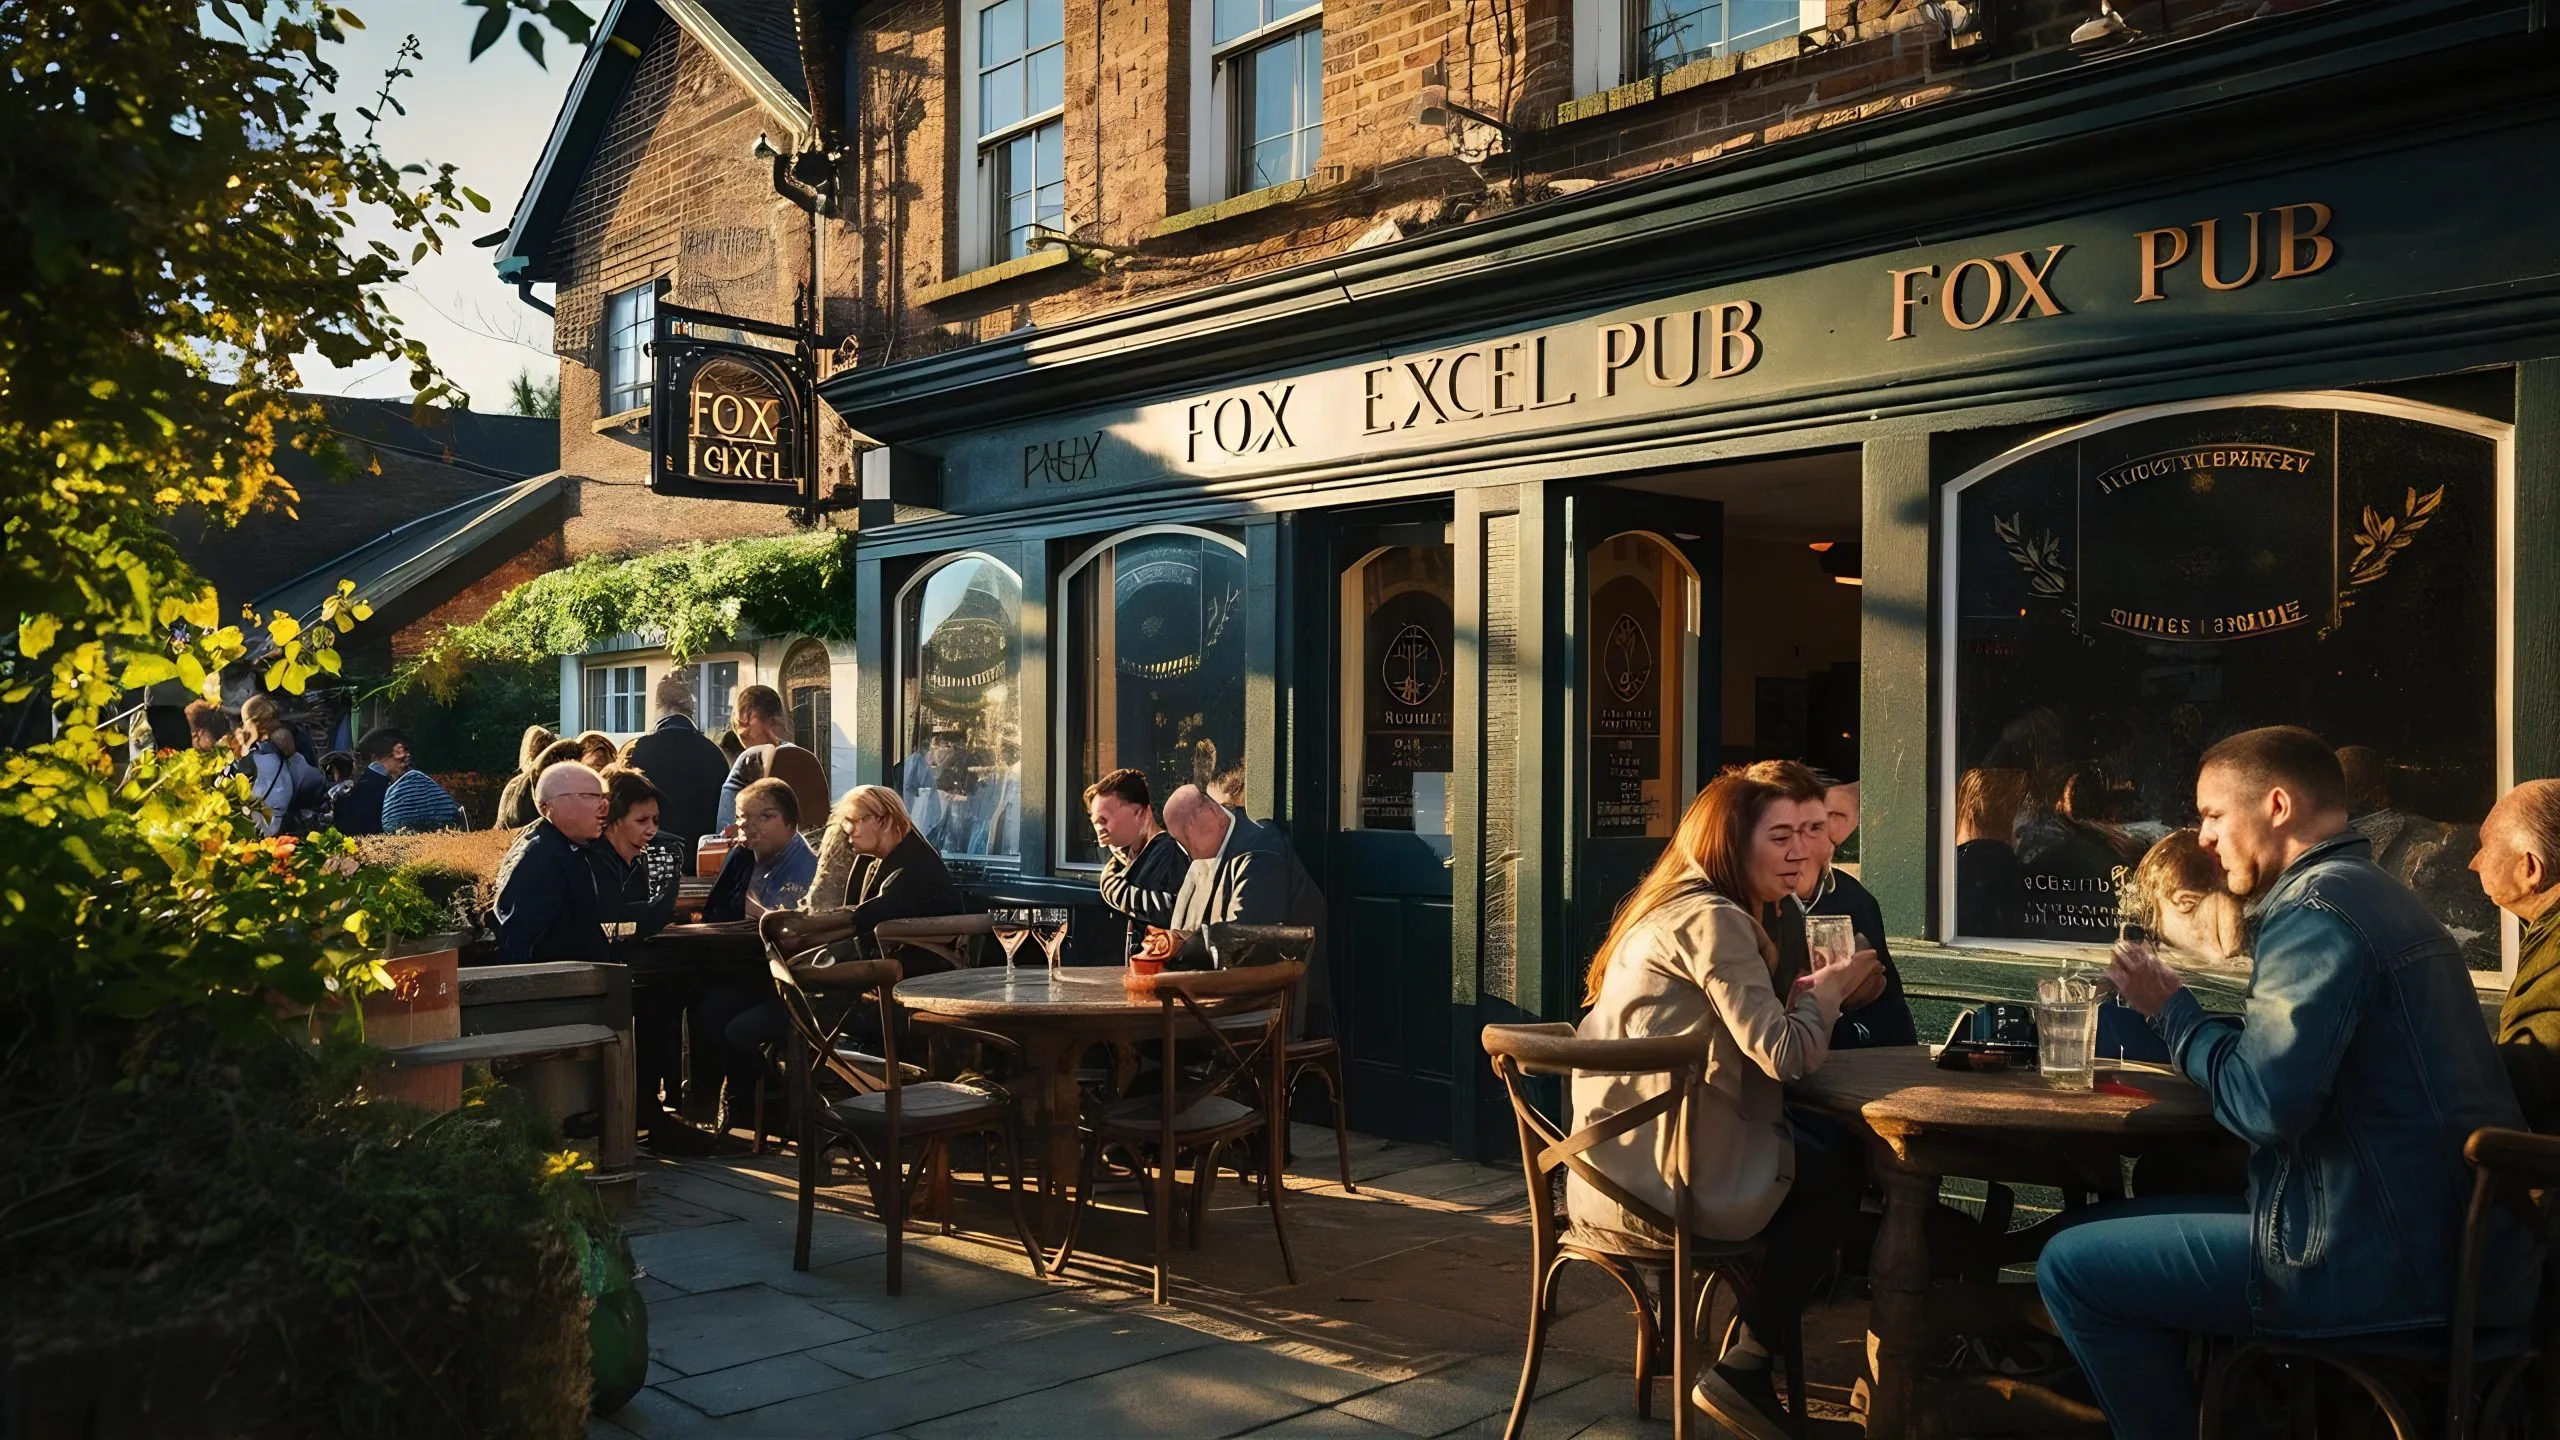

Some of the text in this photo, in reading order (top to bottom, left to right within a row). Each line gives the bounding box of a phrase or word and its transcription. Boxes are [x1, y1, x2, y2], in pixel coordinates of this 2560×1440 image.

[1886, 202, 2335, 341] FOX PUB
[689, 391, 776, 444] FOX
[1187, 300, 1762, 463] FOX EXCEL PUB
